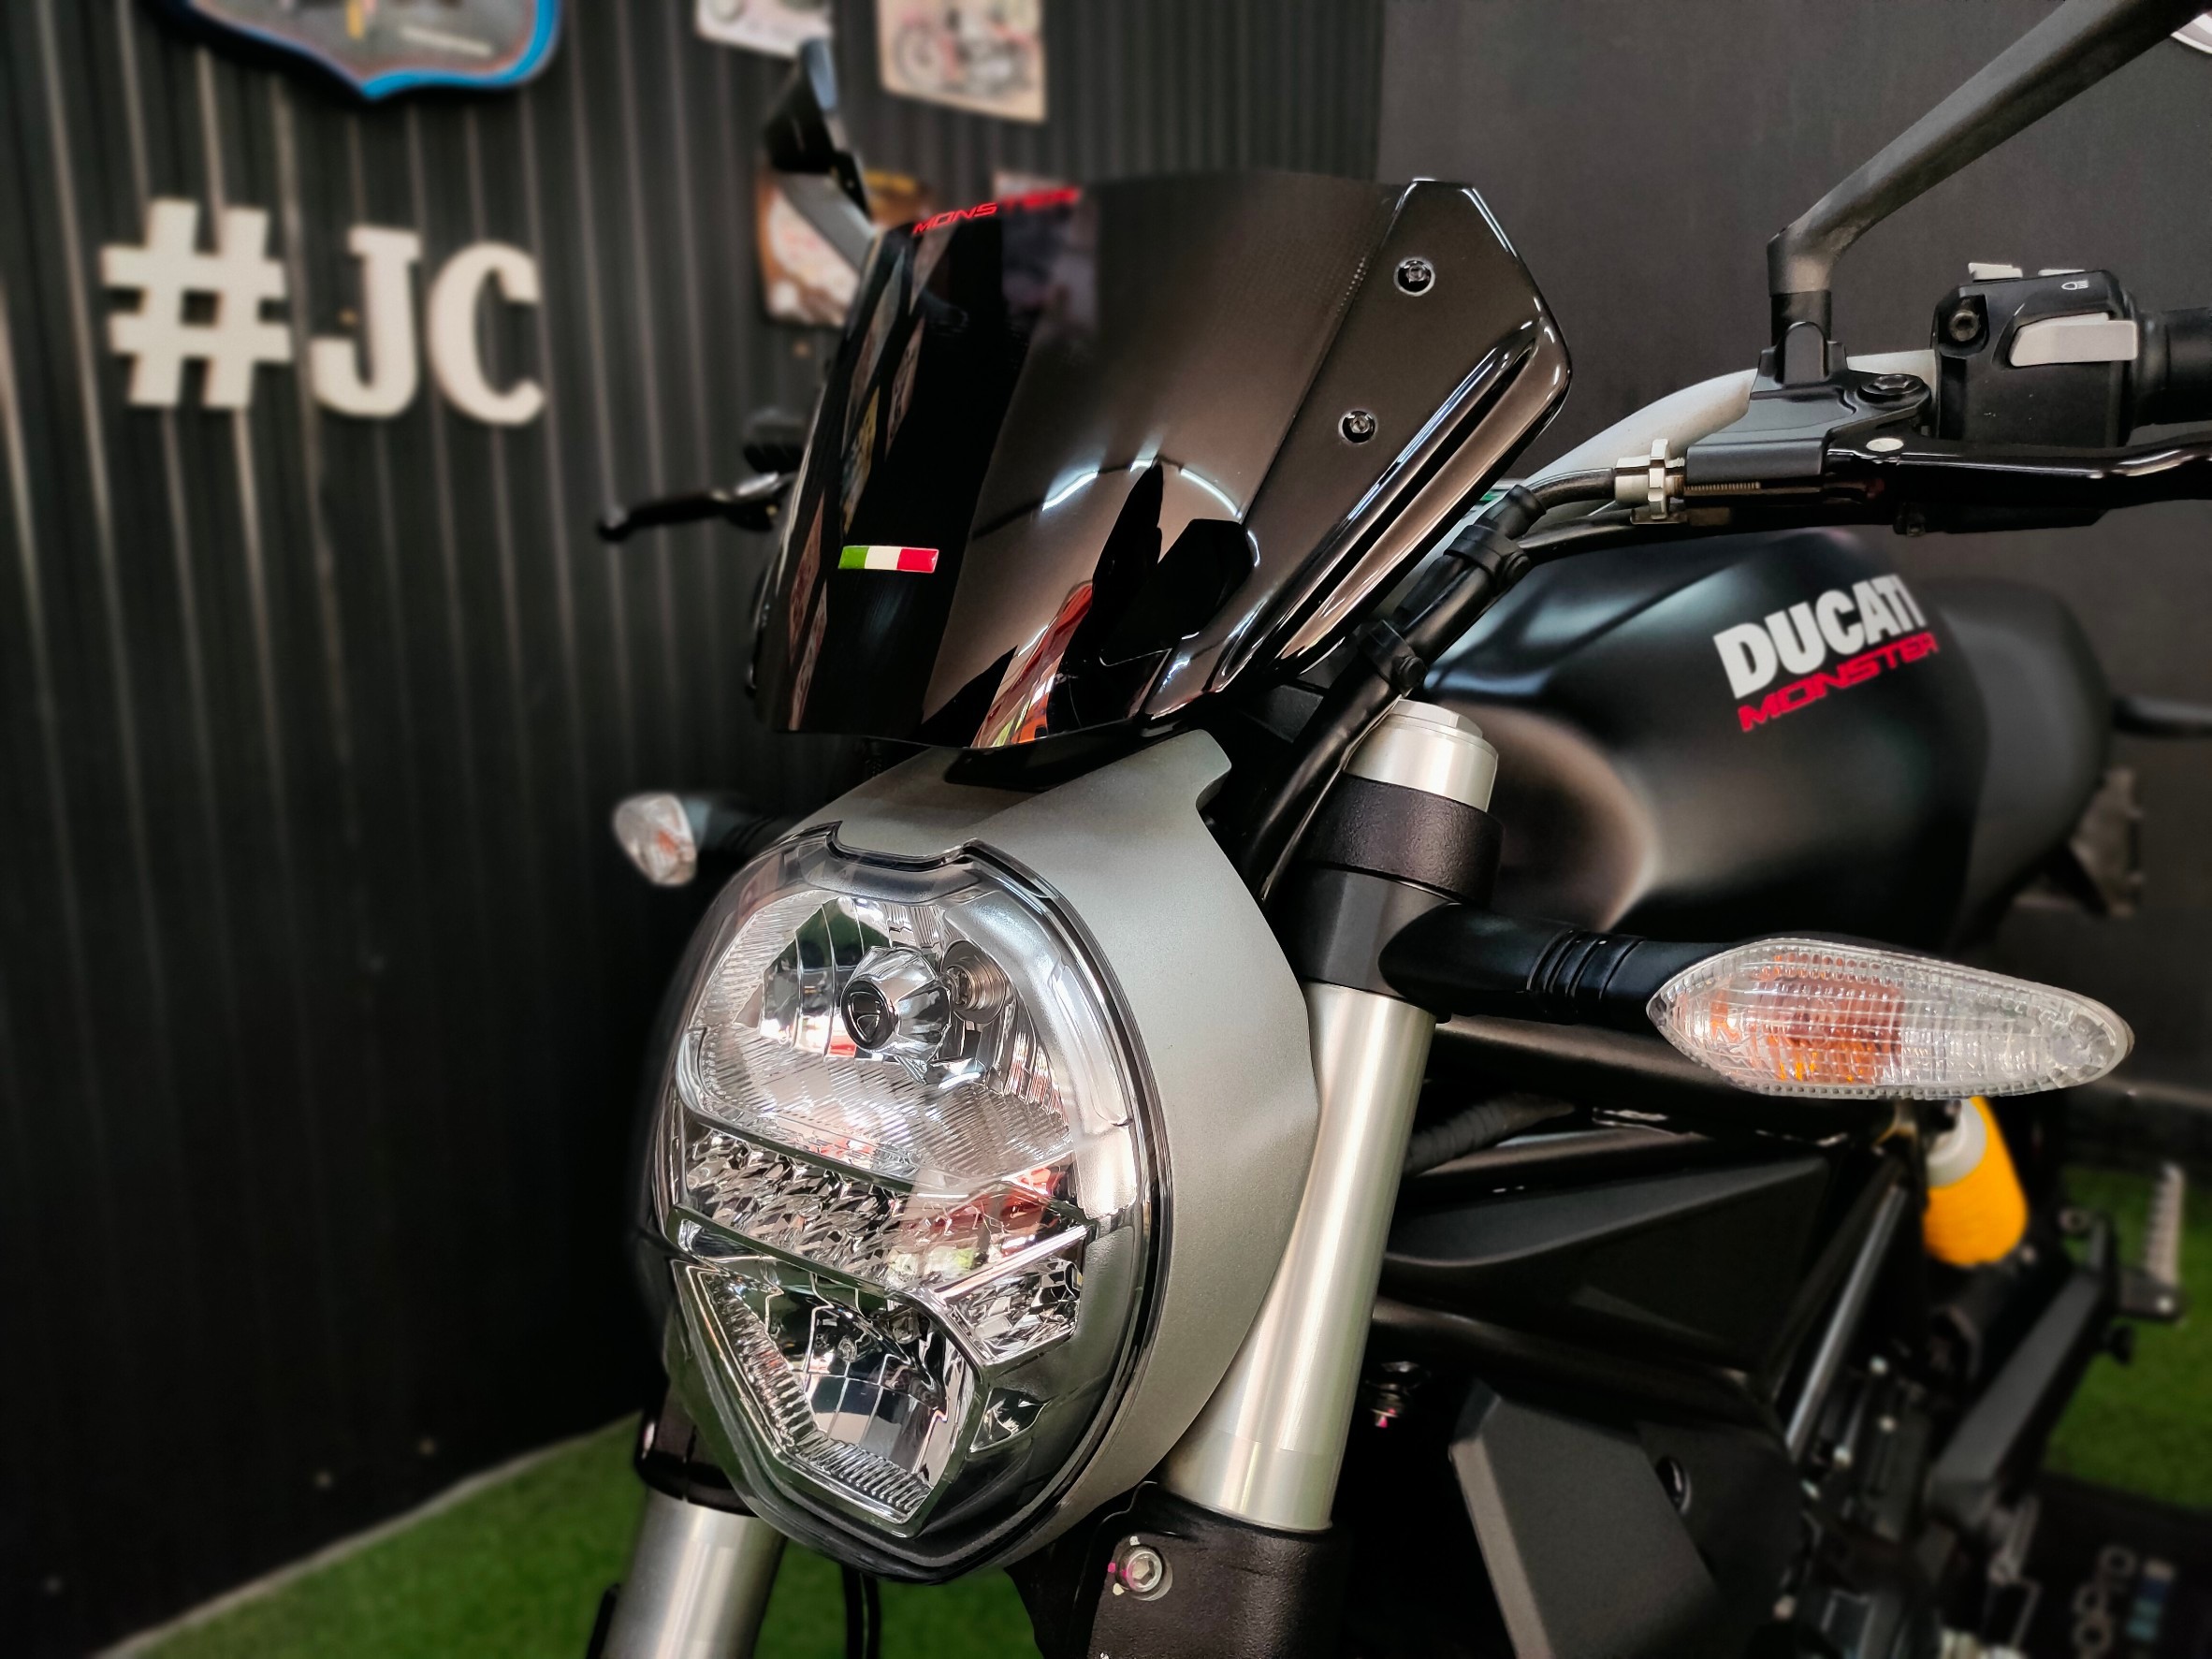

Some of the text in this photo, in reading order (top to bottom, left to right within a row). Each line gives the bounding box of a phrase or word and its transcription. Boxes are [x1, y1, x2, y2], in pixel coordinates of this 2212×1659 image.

[100, 197, 545, 427] #JC
[1713, 574, 1928, 700] DUCATI
[1737, 631, 1940, 732] MONSTER
